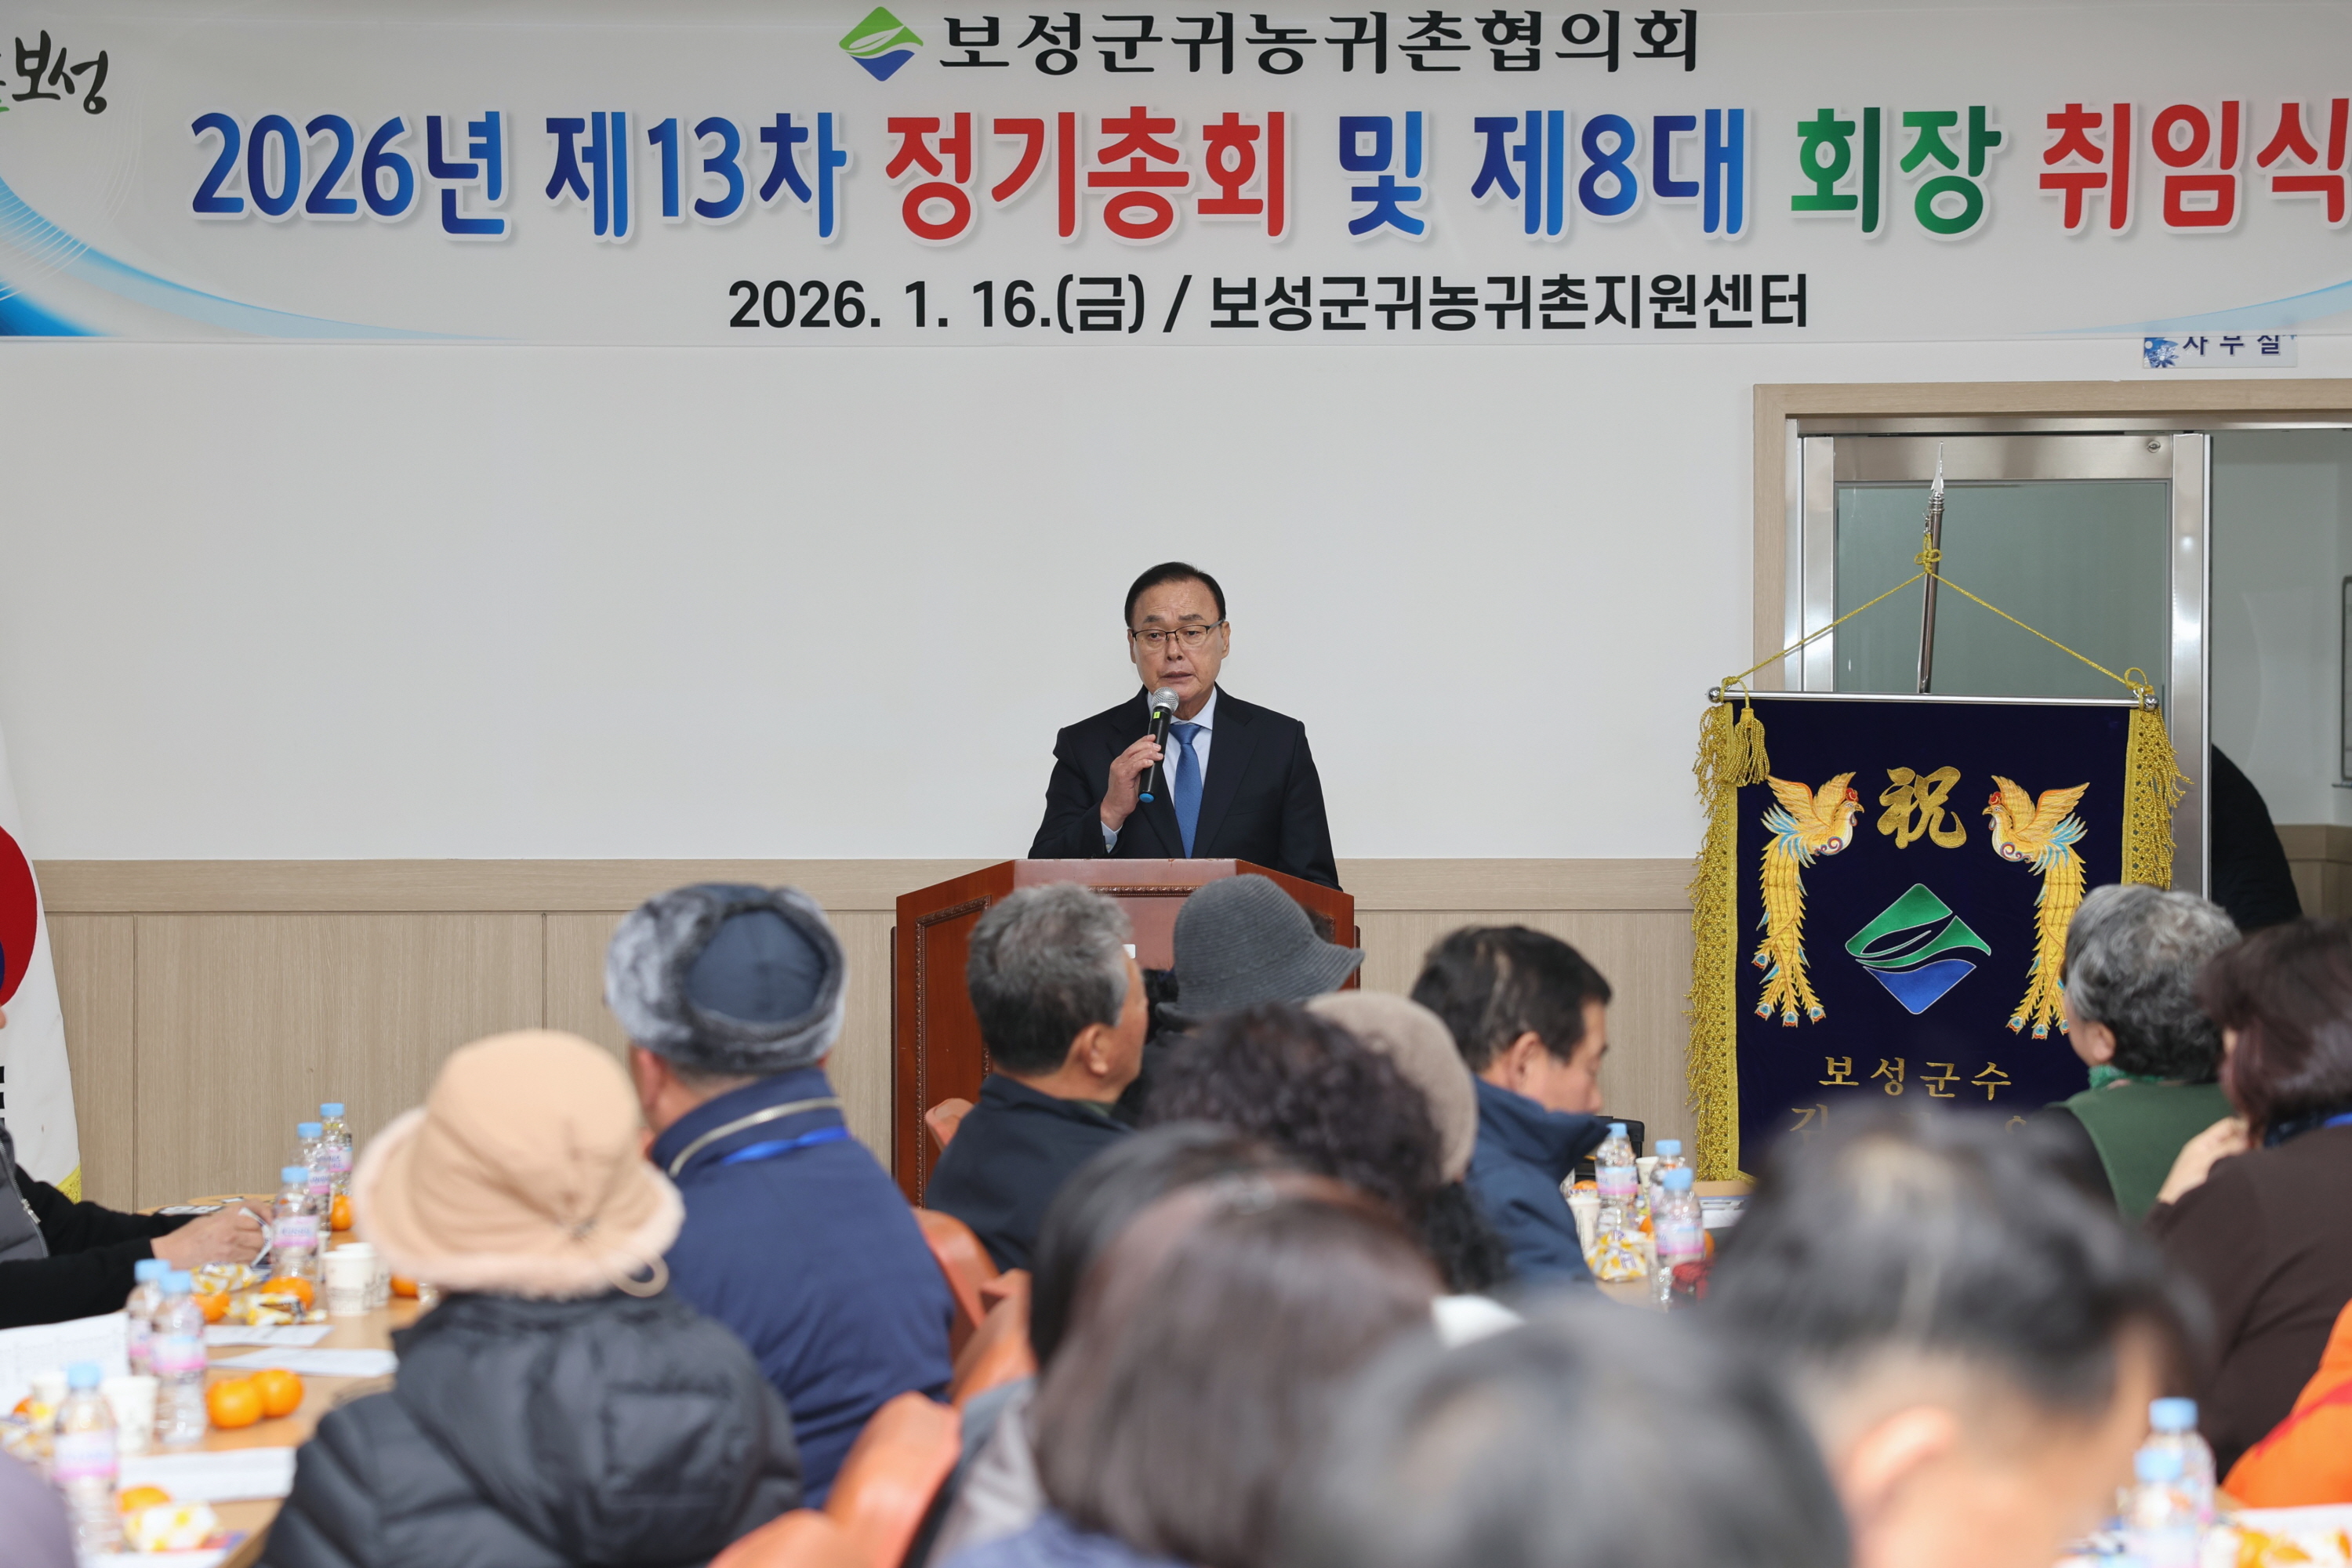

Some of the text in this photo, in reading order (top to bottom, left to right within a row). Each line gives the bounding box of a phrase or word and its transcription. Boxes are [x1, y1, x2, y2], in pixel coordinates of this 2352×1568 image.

[12, 30, 108, 114] 보성
[940, 9, 1697, 75] 보성군귀농귀촌협의회
[191, 98, 2350, 240] 2026년 제13차 정기총회 및 제8대 회장 취임식
[729, 274, 1806, 334] 2026. 1. 16.(금) / 보성군귀농귀촌지원센터
[1877, 765, 1967, 849] 祝
[1819, 1056, 2012, 1101] 보성군수
